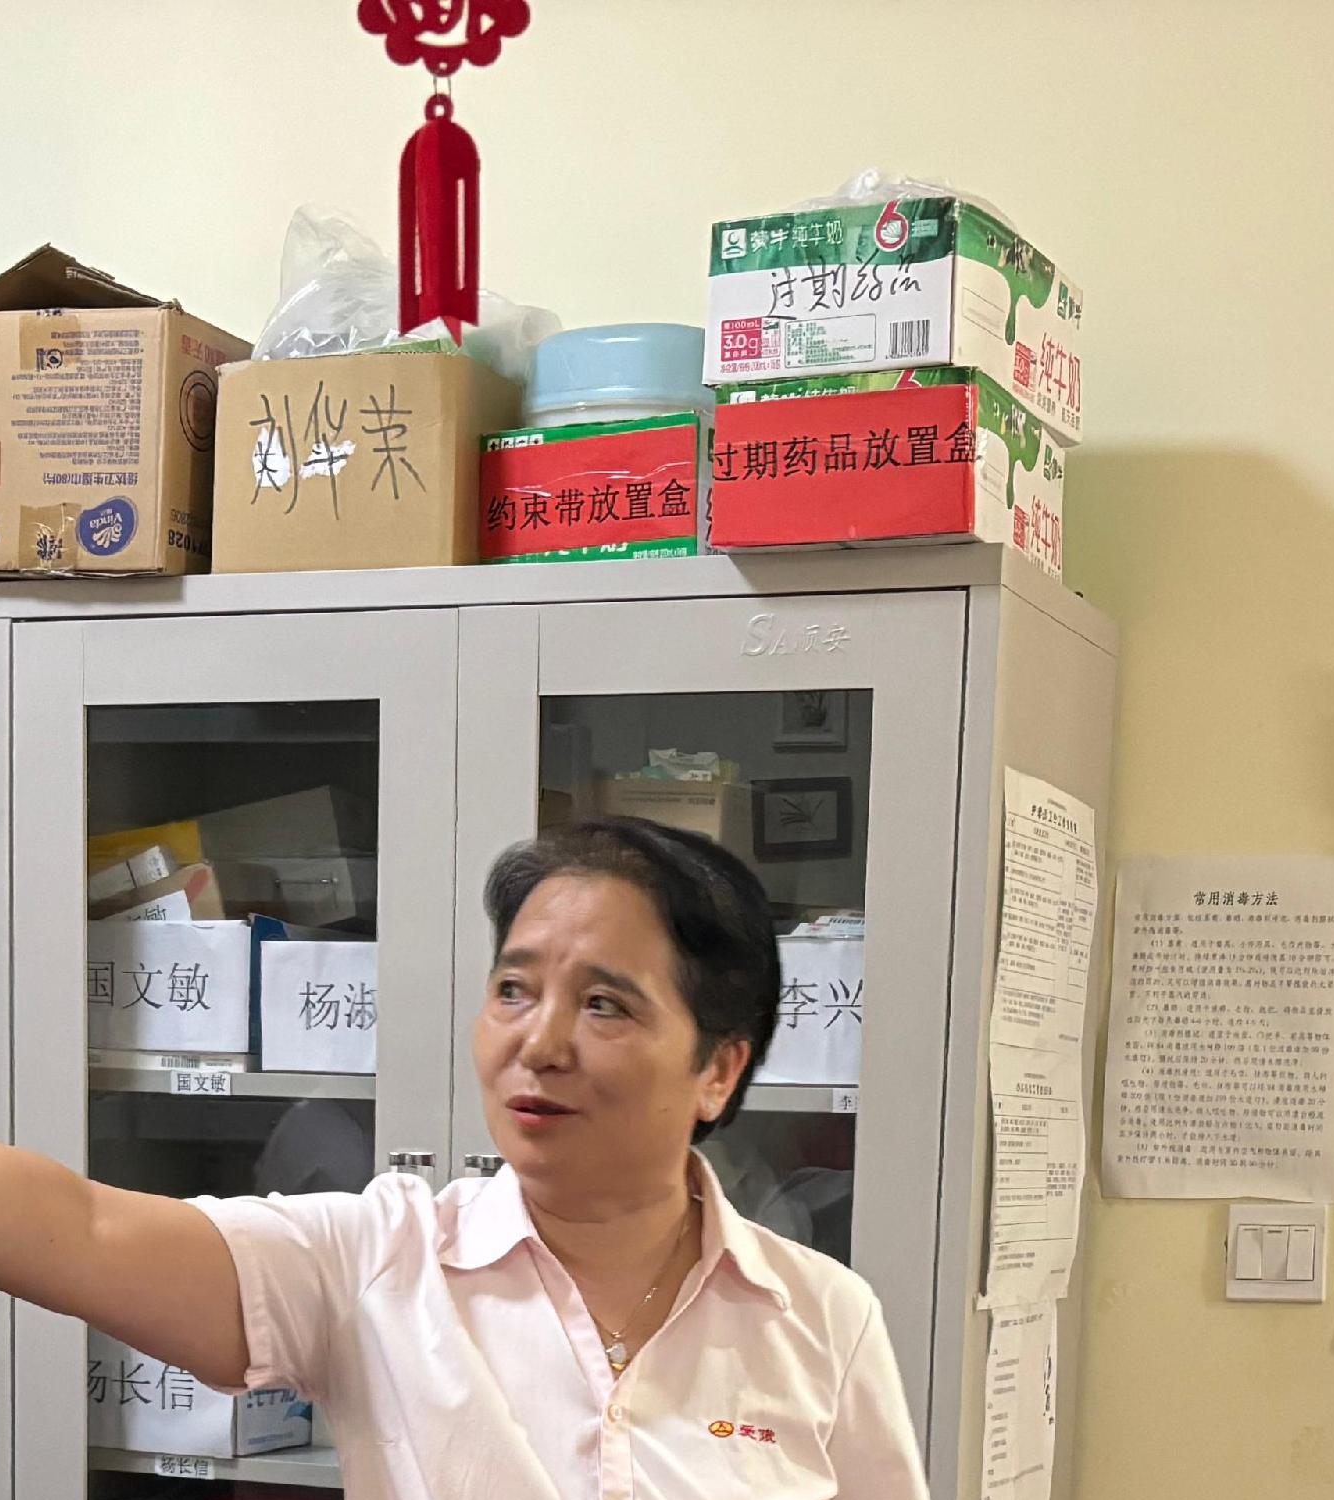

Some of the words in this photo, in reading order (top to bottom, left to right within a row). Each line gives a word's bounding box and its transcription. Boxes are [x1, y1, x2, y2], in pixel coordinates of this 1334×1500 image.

[791, 220, 843, 247] 纯牛奶
[1039, 333, 1081, 413] 纯牛奶
[250, 381, 426, 520] 刘华荣
[712, 421, 976, 481] 过期药品放置盒
[89, 513, 123, 529] Vinda
[488, 478, 691, 531] 约束带放置盒
[1194, 891, 1279, 906] 常用消毒方法
[87, 961, 211, 1012] 国文敏
[777, 977, 863, 1029] 李兴
[176, 1074, 226, 1093] 国文敏
[161, 1459, 209, 1476] 杨长信
